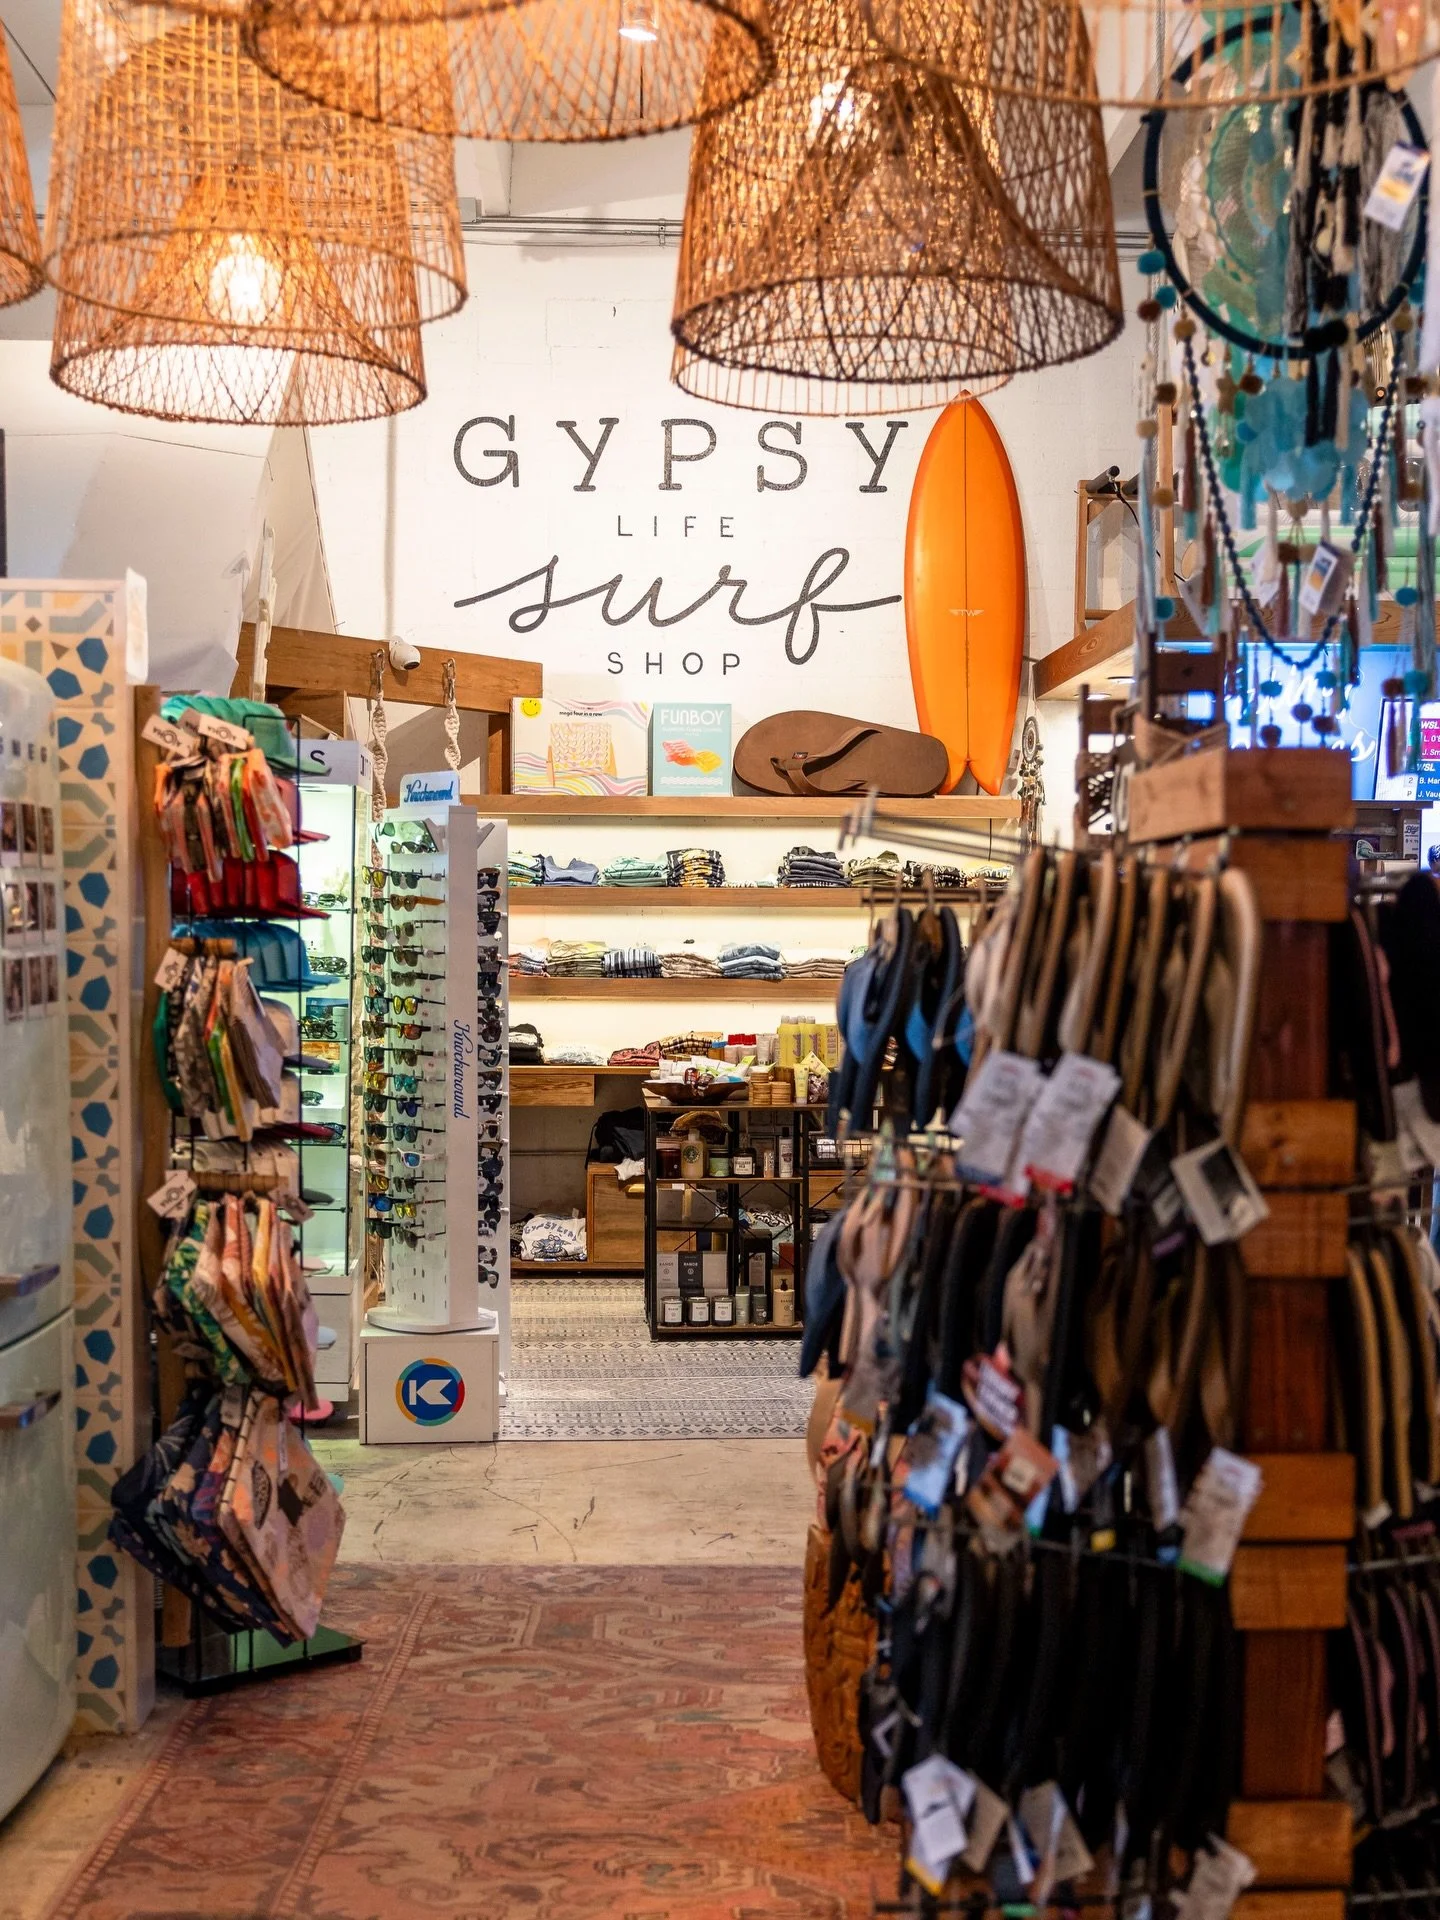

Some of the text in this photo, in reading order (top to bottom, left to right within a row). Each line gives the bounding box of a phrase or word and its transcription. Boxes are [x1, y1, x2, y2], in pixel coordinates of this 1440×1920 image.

[452, 413, 908, 494] GYPSY
[616, 514, 735, 538] LIFE
[453, 546, 903, 665] surf
[607, 651, 742, 676] SHOP
[660, 708, 724, 725] FUNBOY
[452, 1018, 475, 1120] Knockaround
